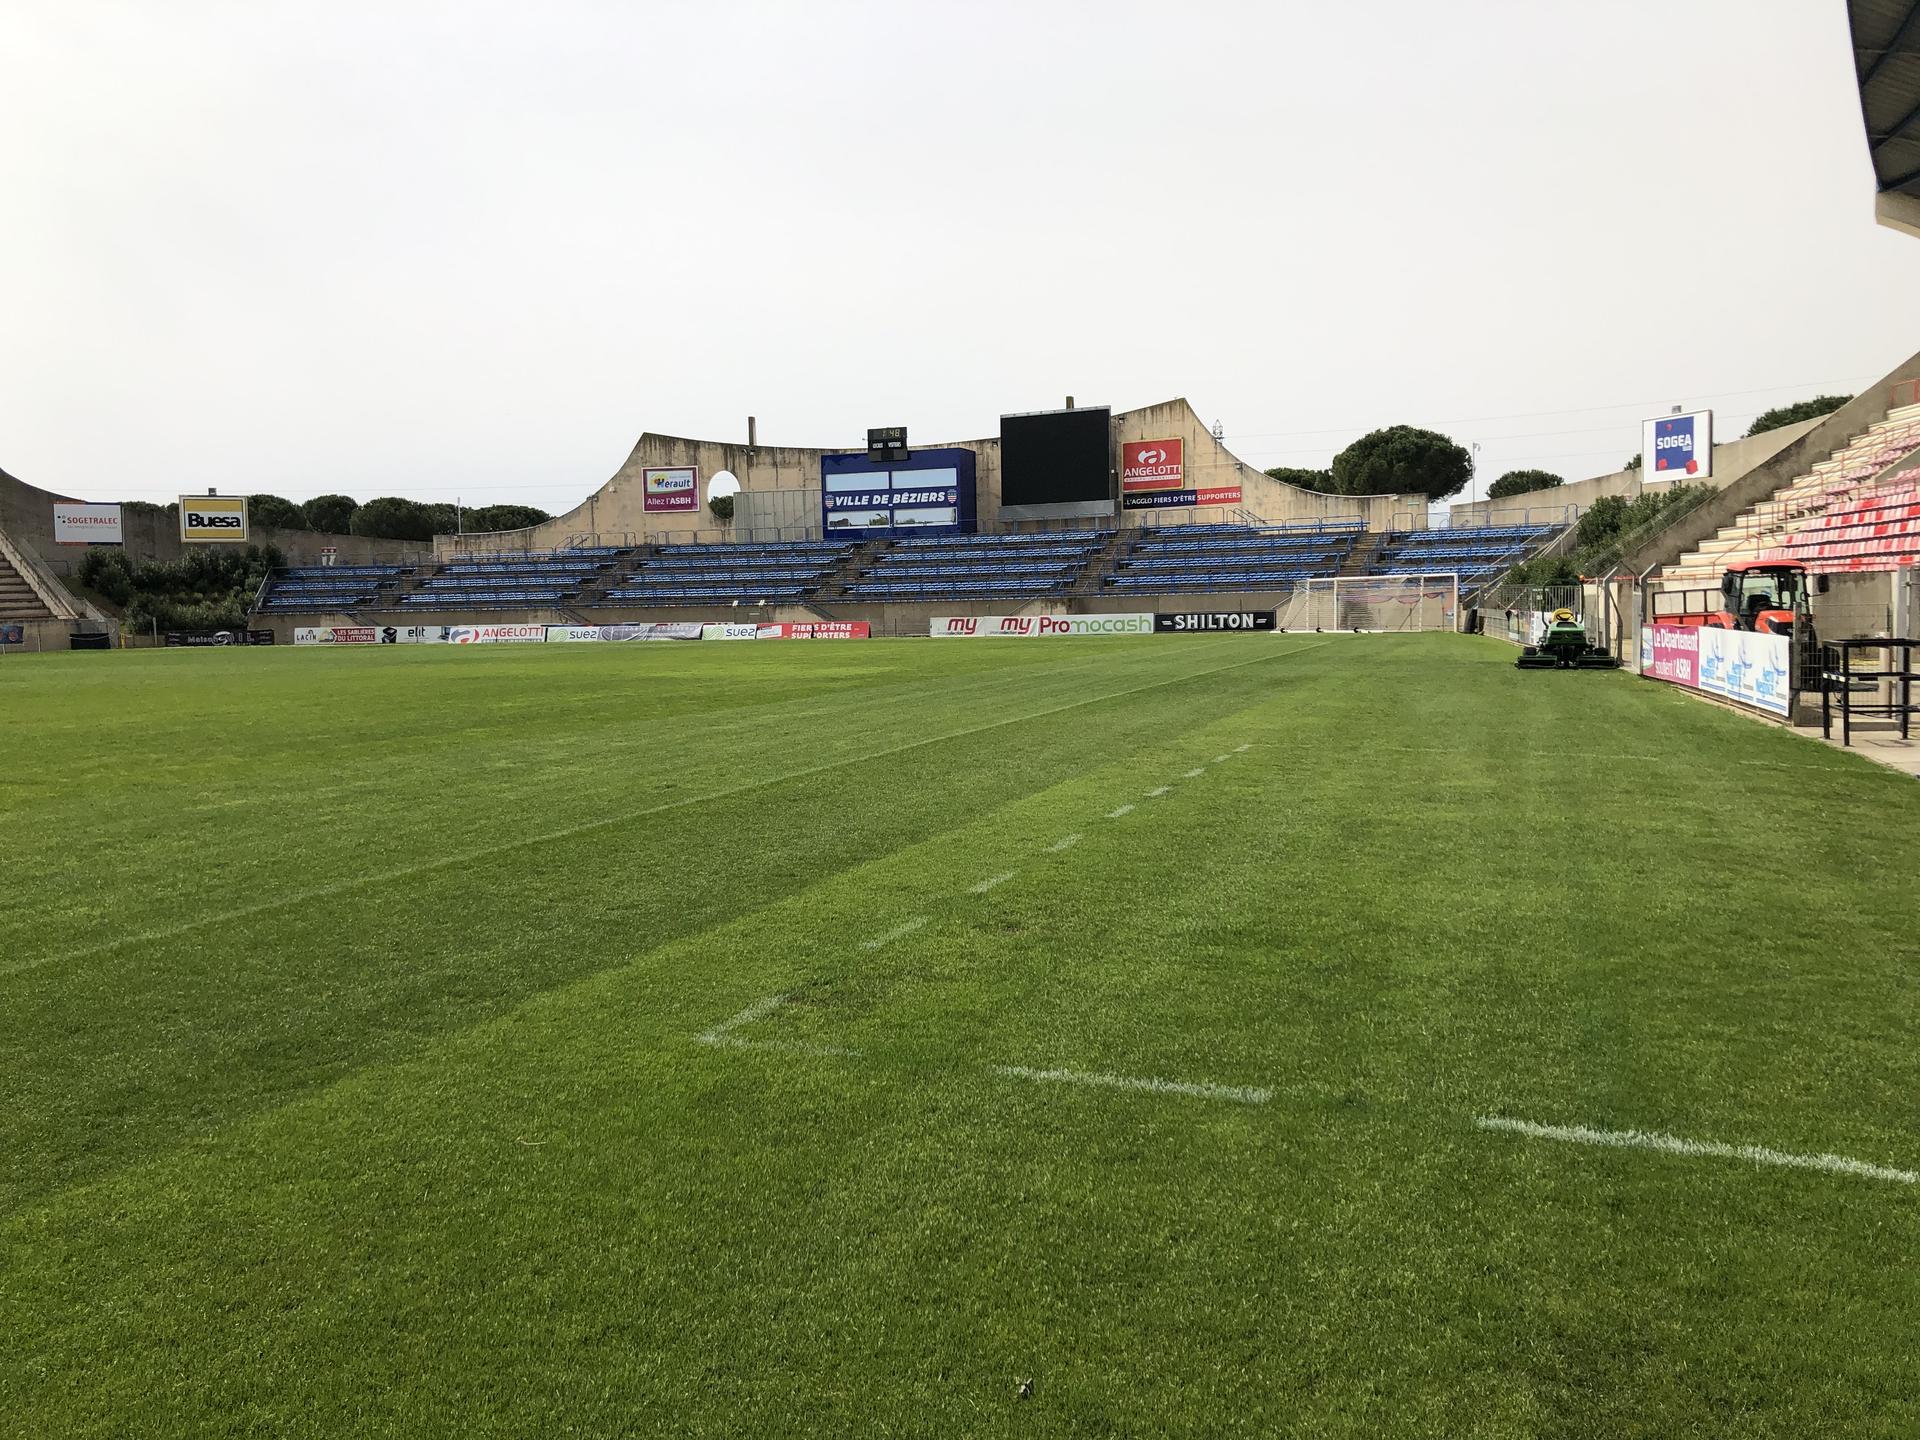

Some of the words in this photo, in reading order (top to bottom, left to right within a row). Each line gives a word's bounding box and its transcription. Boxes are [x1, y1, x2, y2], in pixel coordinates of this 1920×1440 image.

[1656, 434, 1692, 450] SOGEA
[1124, 465, 1181, 477] ANGELOTTI
[647, 497, 665, 505] Allez
[835, 495, 869, 506] VILLE
[872, 494, 889, 505] DE
[1153, 496, 1172, 504] FIERS
[1173, 494, 1196, 503] D'ÊTRE
[1197, 491, 1241, 502] SUPPORTERS
[67, 516, 118, 525] SOGETRALEC
[187, 512, 241, 528] Buesa
[792, 624, 819, 632] FIERS
[821, 621, 852, 631] D'ÊTRE
[947, 618, 977, 636] my
[1000, 617, 1031, 636] my
[1039, 615, 1152, 633] Promocash
[1174, 613, 1254, 630] SHILTON
[482, 626, 544, 638] ANGELOTTI
[1653, 628, 1661, 647] Le
[1661, 628, 1698, 652] Département
[1655, 658, 1674, 676] soutient
